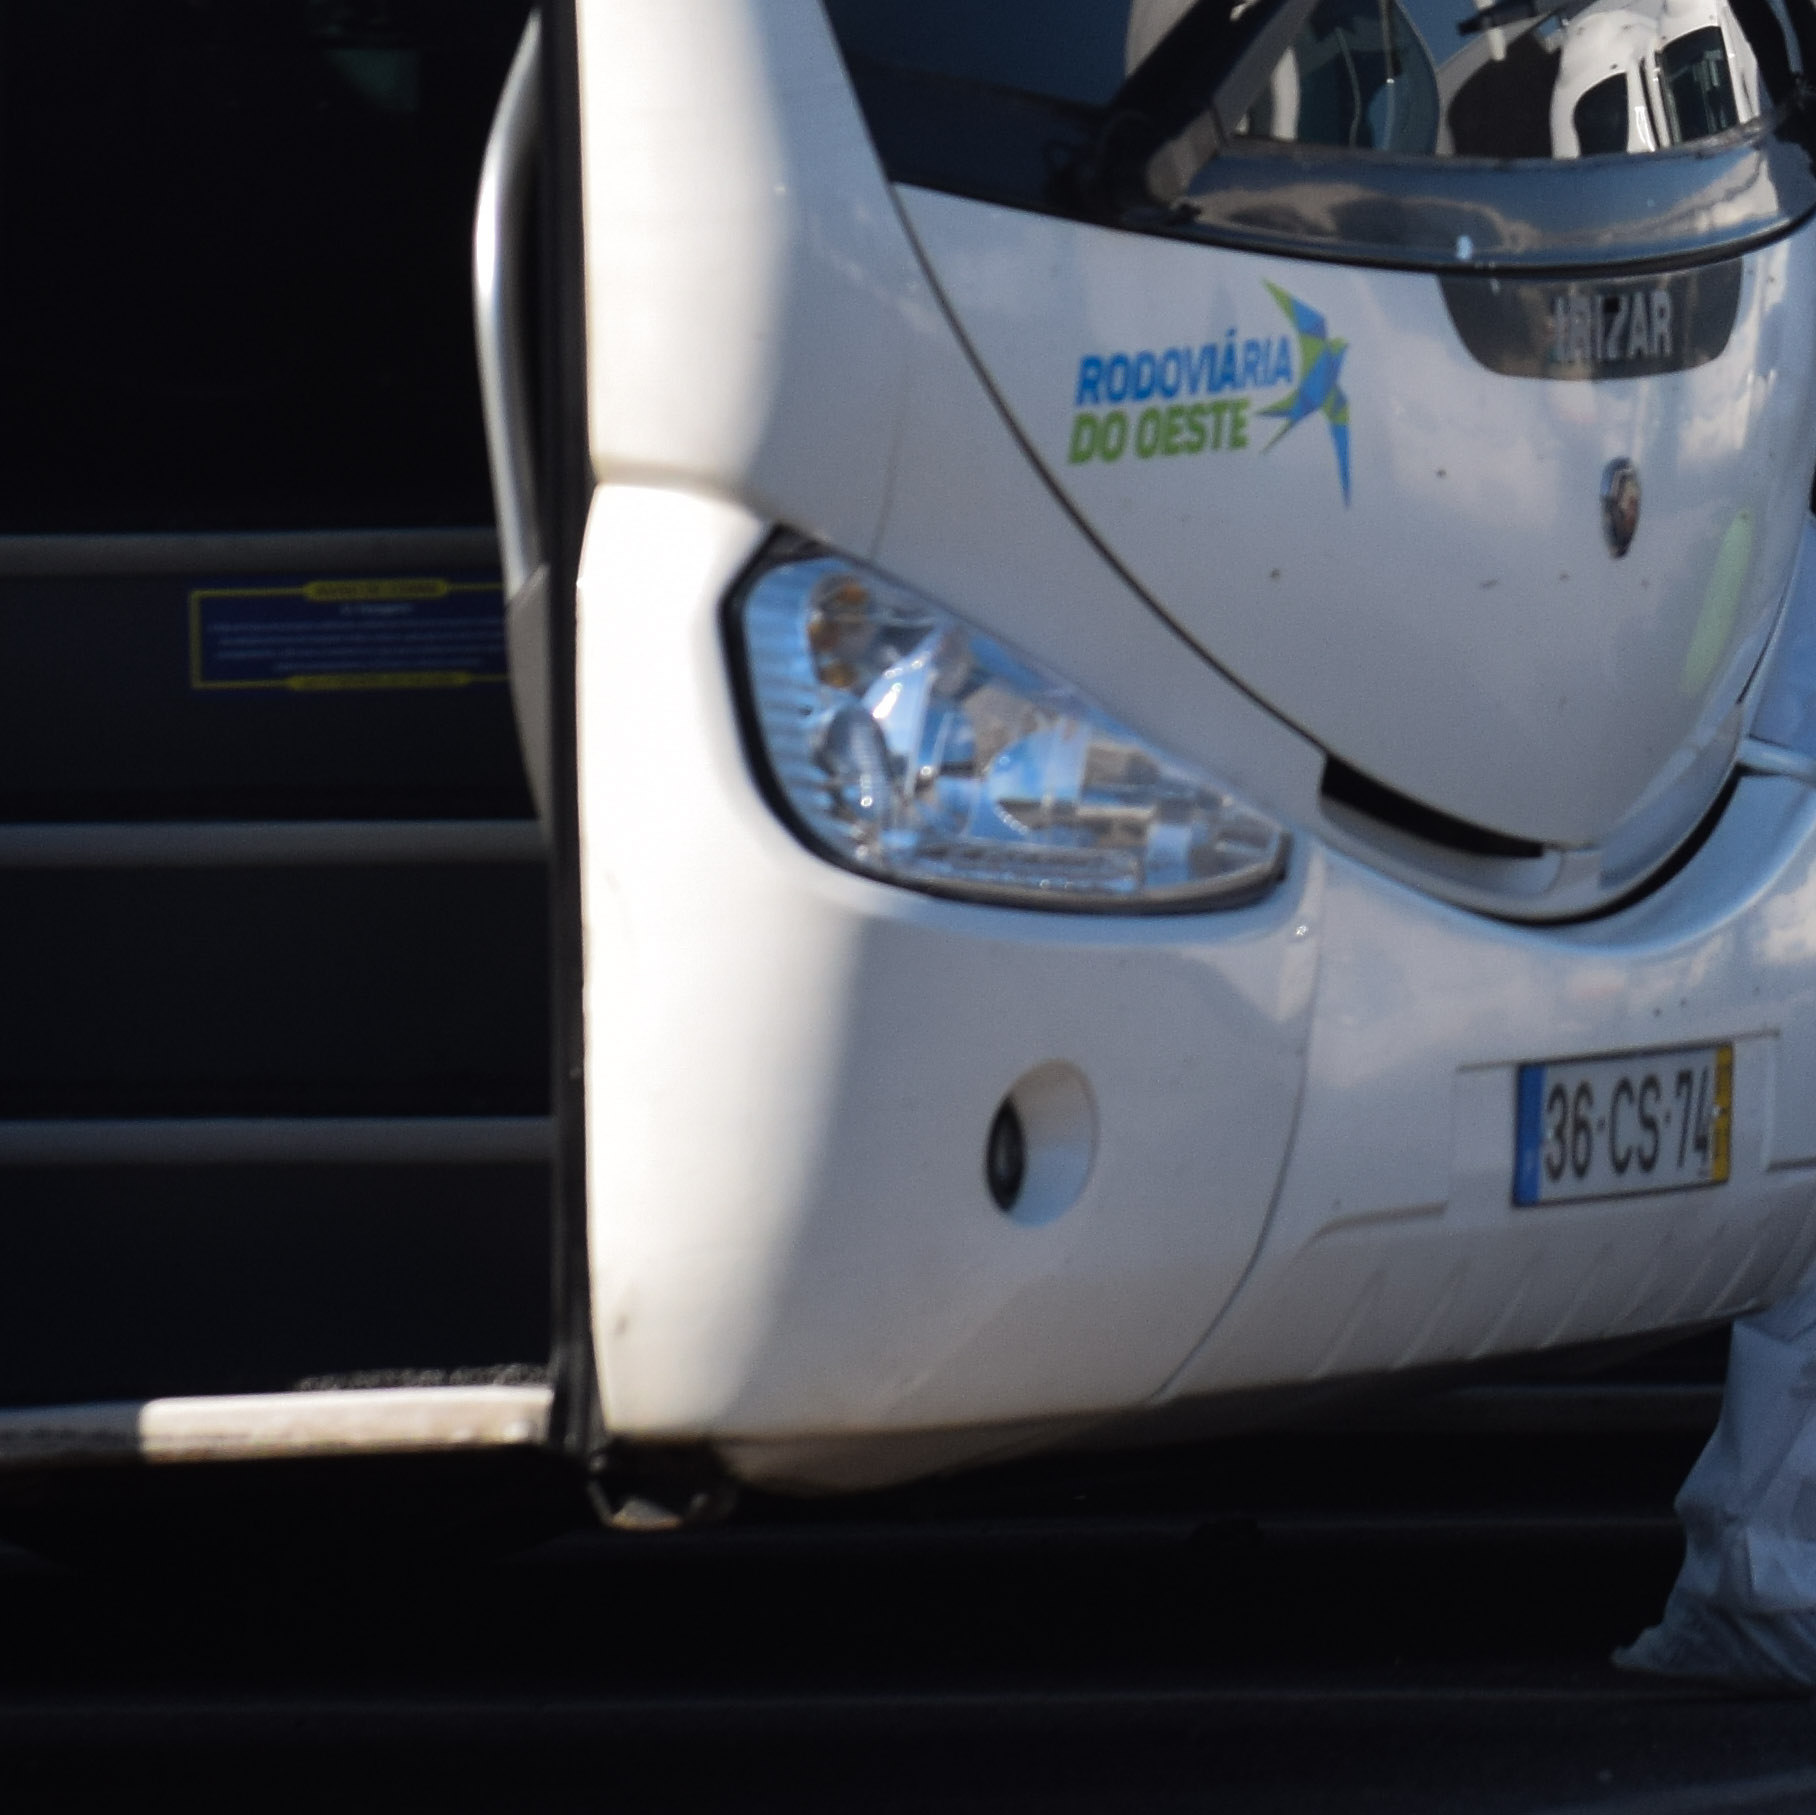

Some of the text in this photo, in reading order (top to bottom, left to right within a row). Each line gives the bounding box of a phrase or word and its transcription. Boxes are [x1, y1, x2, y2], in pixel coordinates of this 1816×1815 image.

[1076, 328, 1293, 406] RODOVIÁRIA
[1068, 397, 1250, 464] DO OESTE
